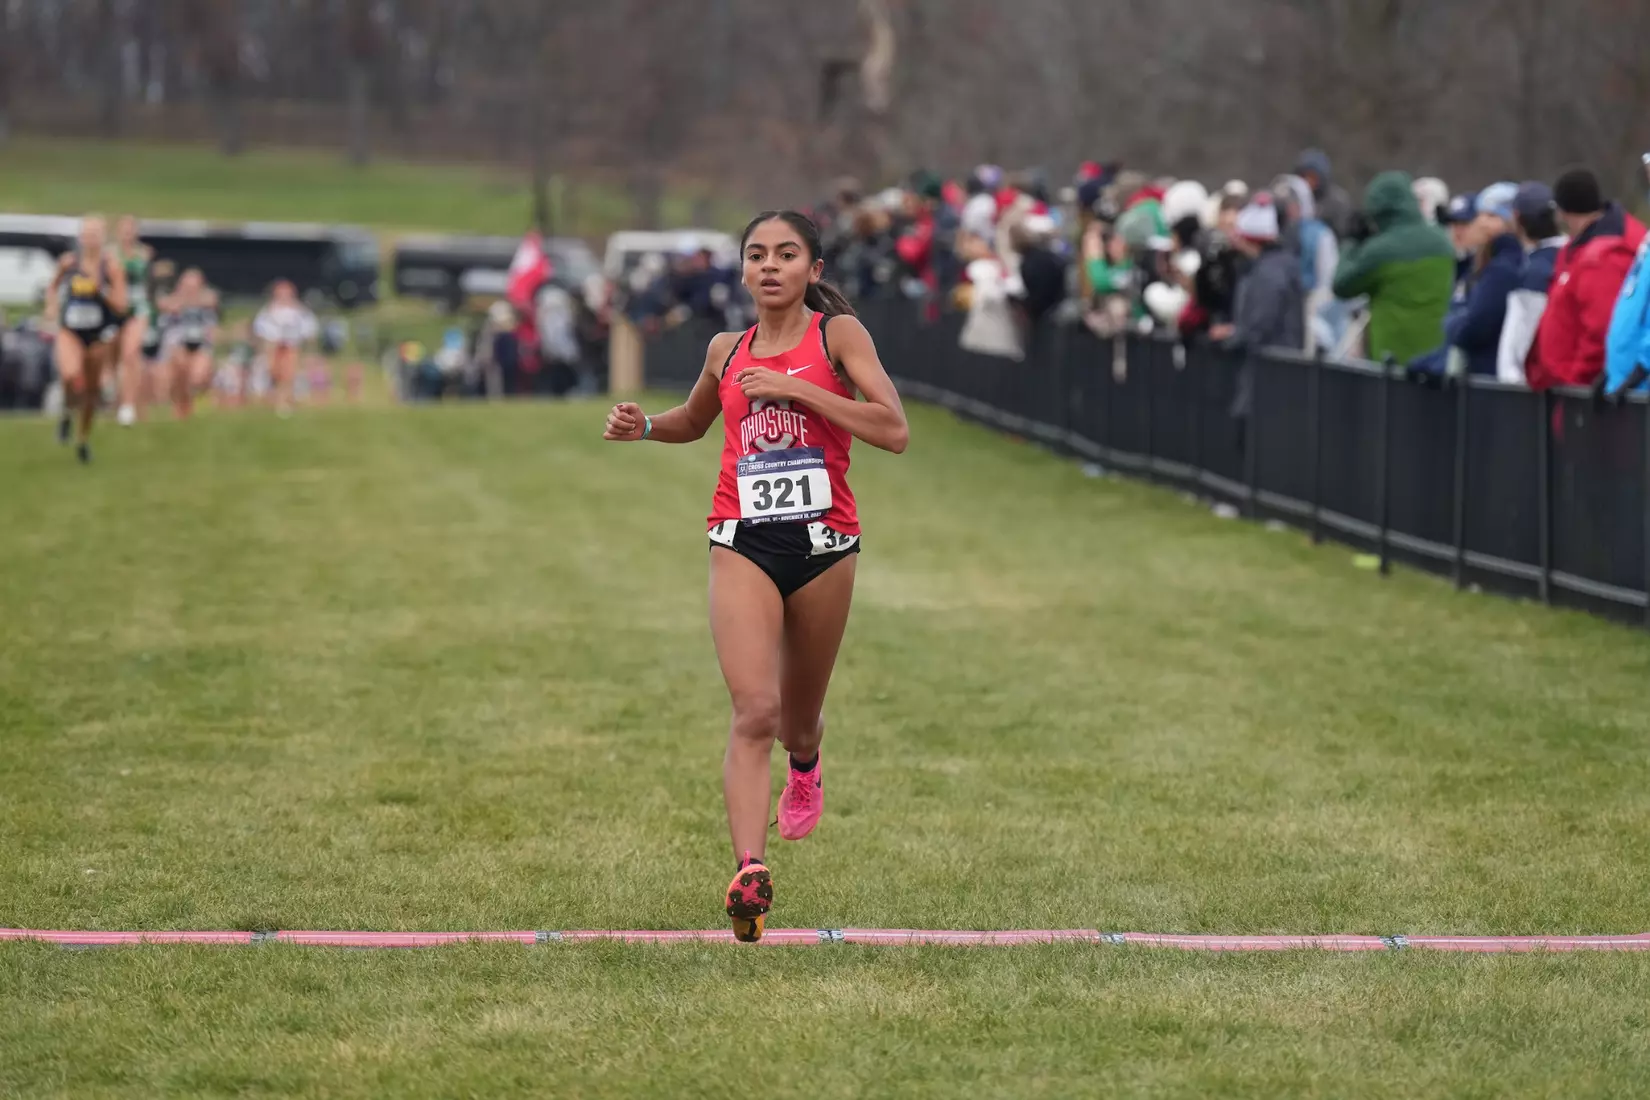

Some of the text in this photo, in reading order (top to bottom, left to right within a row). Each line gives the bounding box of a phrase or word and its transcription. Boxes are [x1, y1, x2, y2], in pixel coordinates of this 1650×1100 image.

[741, 406, 808, 455] OHIO STATE
[765, 461, 787, 469] COUNTRY
[787, 458, 824, 466] CHAMPIONSHIPS
[752, 475, 812, 511] 321
